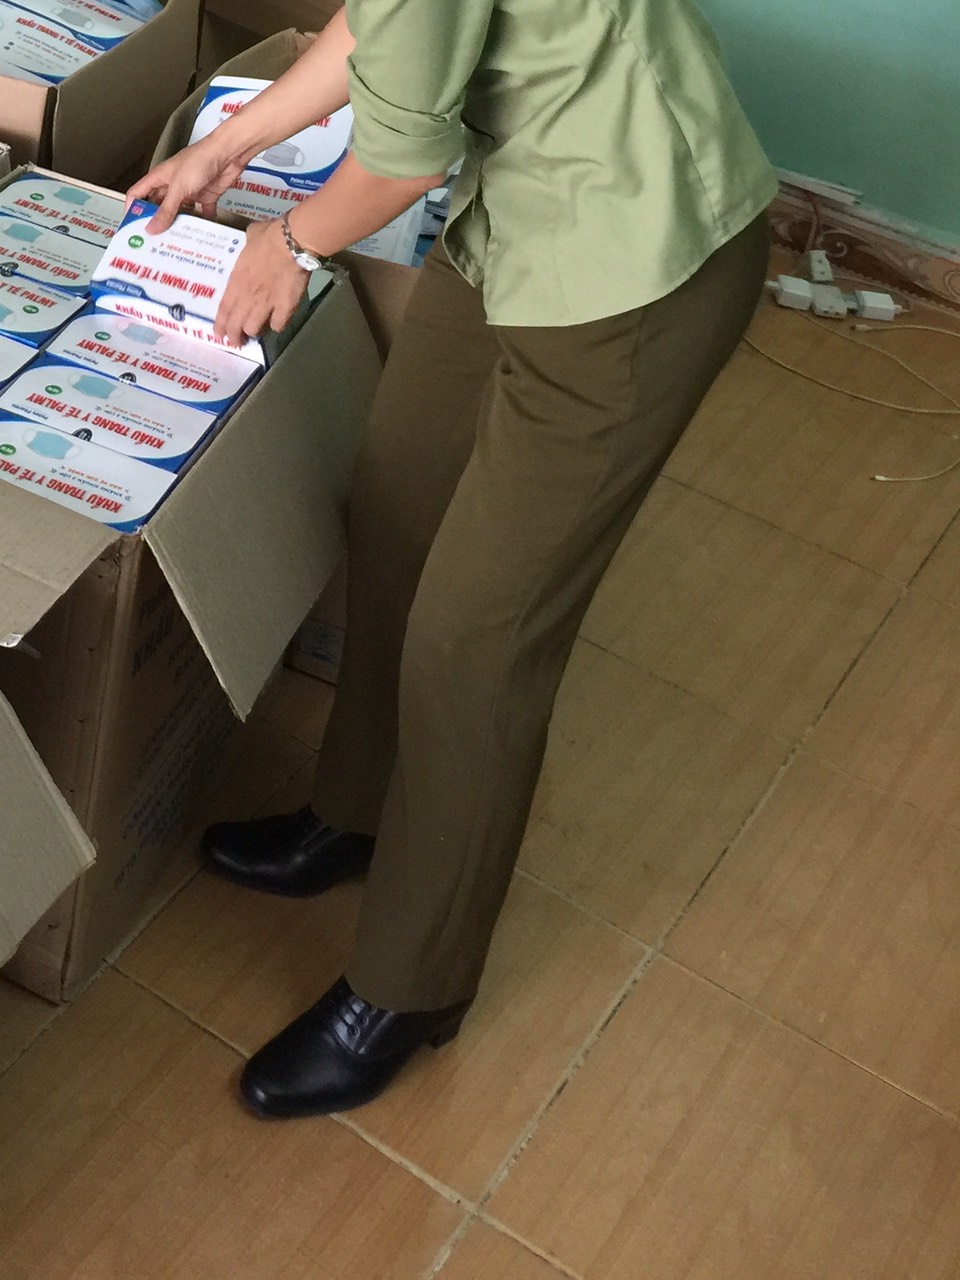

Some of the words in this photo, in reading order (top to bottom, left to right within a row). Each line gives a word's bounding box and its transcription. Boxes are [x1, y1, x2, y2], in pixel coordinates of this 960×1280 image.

[246, 182, 271, 197] TRANG
[280, 189, 292, 200] TẾ
[290, 192, 310, 202] PAL
[110, 257, 138, 271] PALMY
[140, 265, 152, 281] TẾ
[152, 270, 159, 279] Y
[160, 275, 189, 291] TRANG
[190, 283, 216, 299] KHẨU
[25, 391, 67, 413] PALMY
[80, 412, 91, 422] Y
[90, 415, 130, 437] TRANG
[34, 474, 46, 485] Y
[45, 477, 86, 501] TRANG
